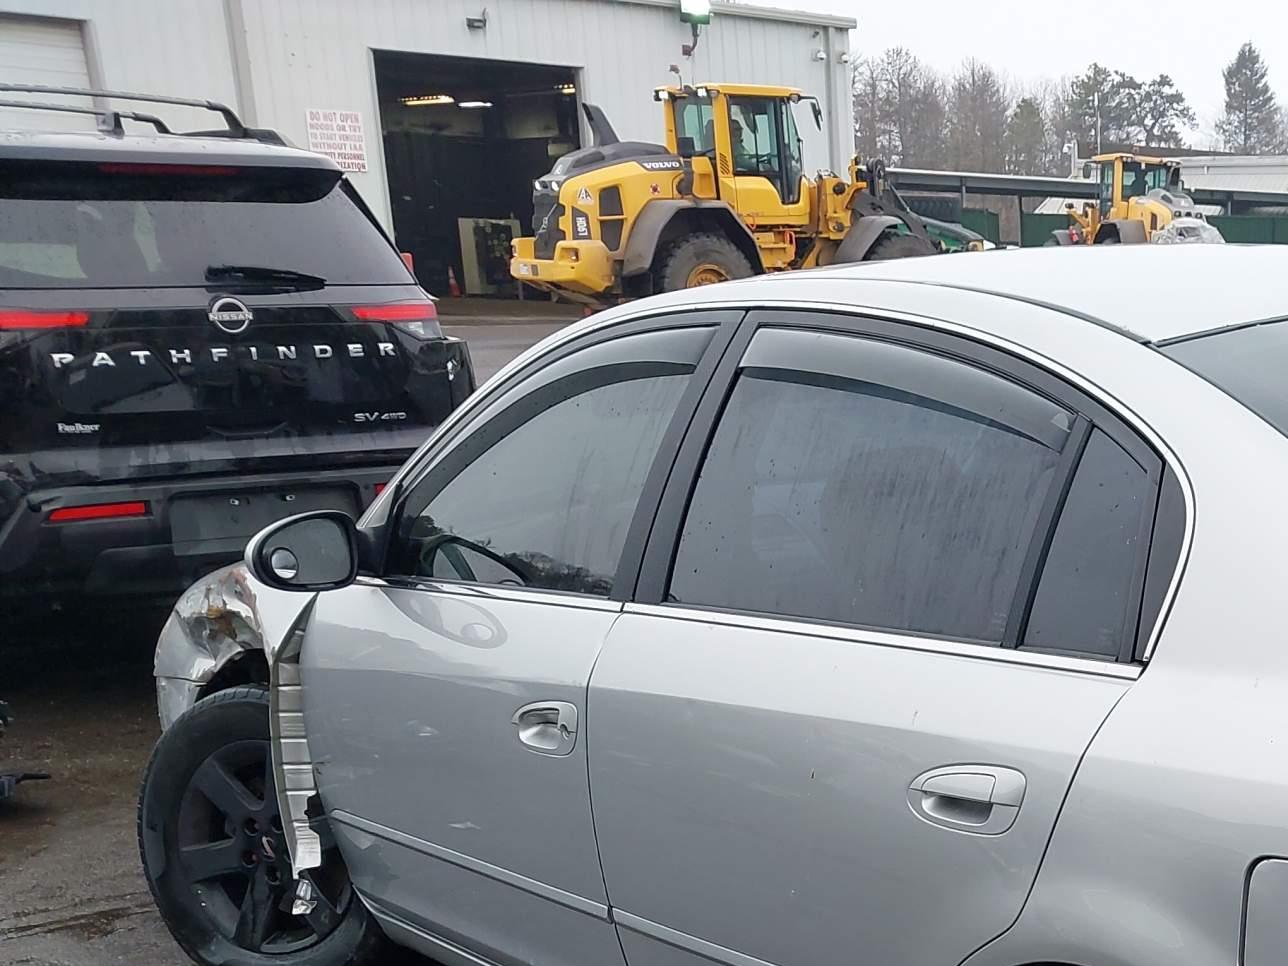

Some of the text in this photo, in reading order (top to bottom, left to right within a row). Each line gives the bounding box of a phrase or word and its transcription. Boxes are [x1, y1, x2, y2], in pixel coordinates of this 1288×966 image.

[309, 111, 360, 123] DO NOT OPEN
[311, 142, 347, 151] WITHOUT
[337, 152, 365, 161] PERSONNEL
[641, 161, 680, 169] VOLVO
[575, 216, 589, 237] L90H
[208, 311, 254, 321] NISSAN
[50, 342, 396, 368] PATHFINDER
[354, 412, 407, 422] SV 4WD
